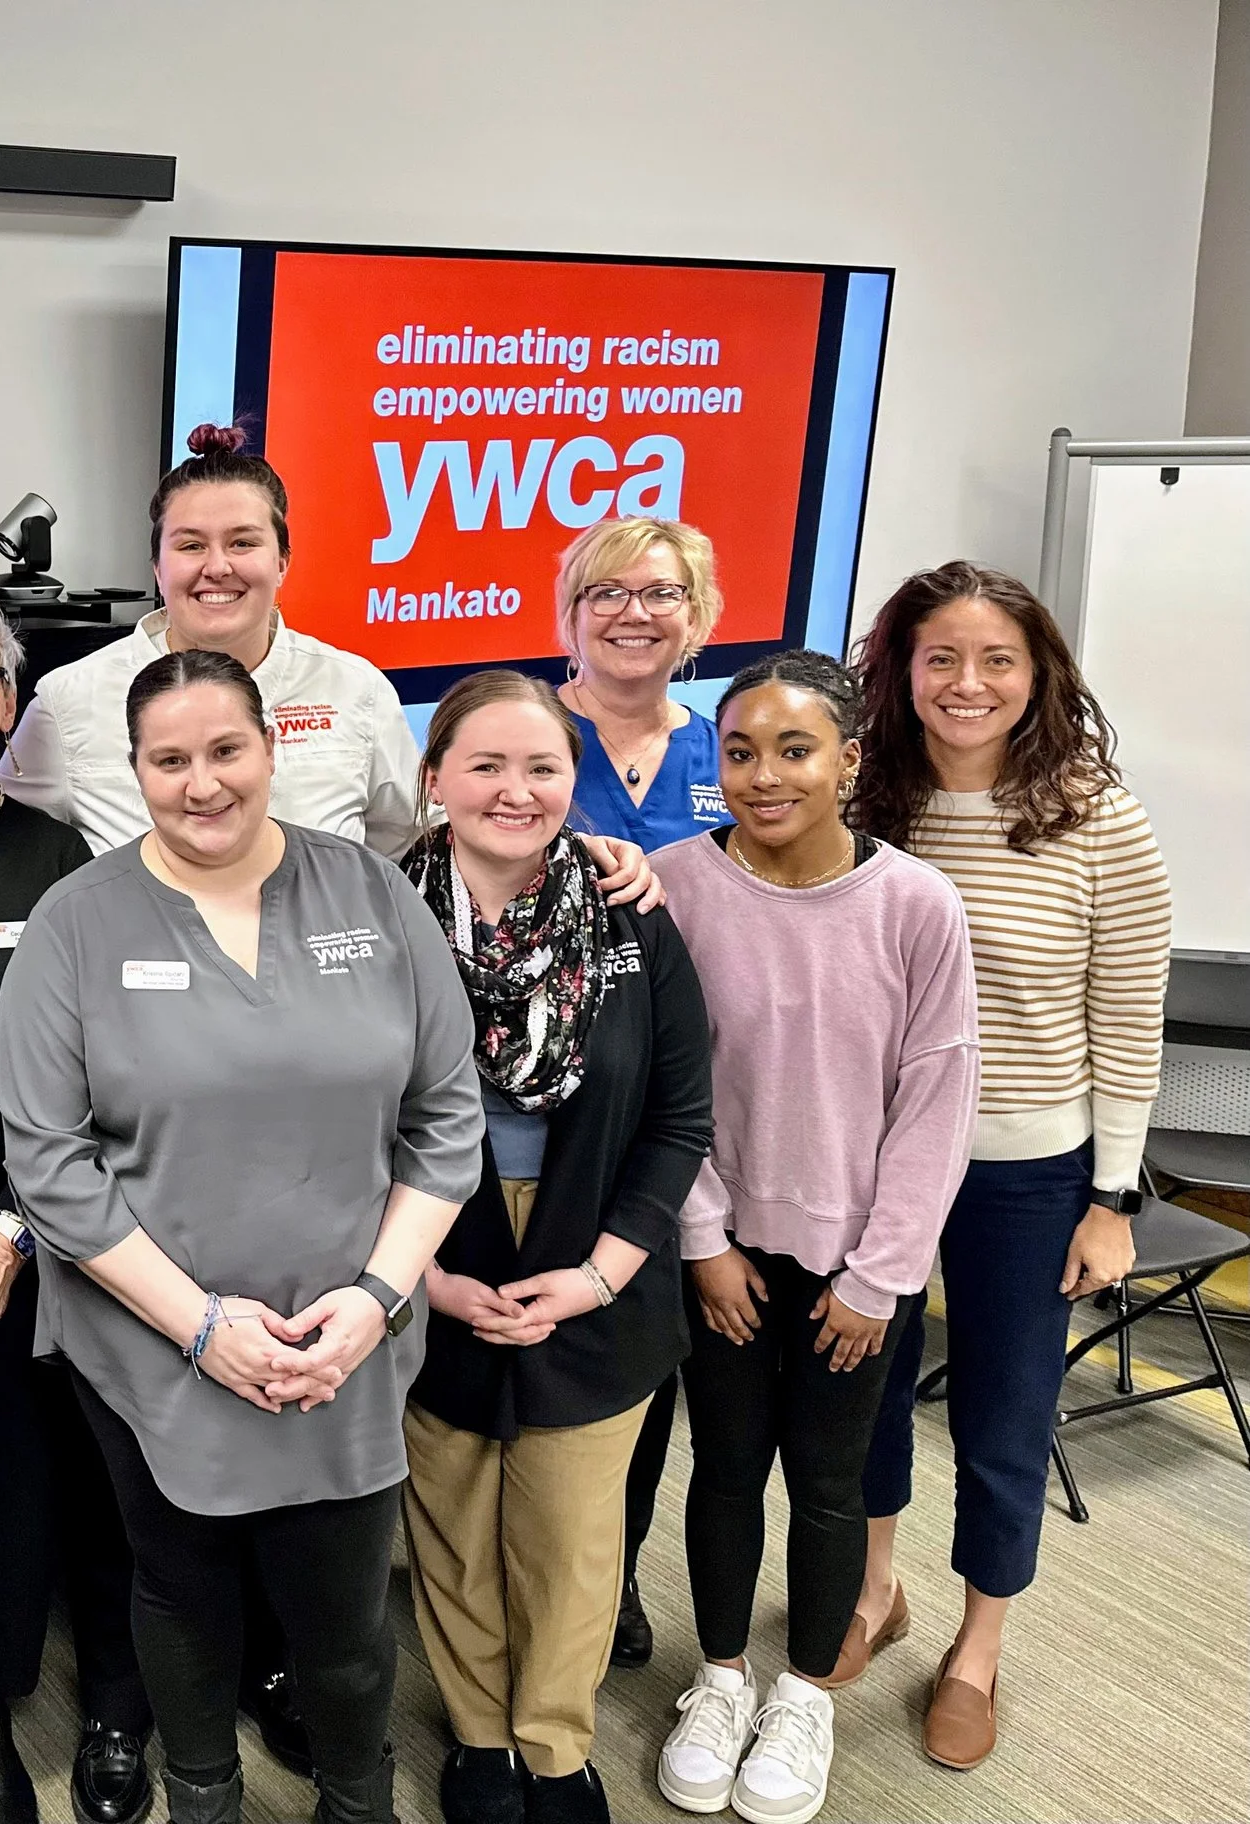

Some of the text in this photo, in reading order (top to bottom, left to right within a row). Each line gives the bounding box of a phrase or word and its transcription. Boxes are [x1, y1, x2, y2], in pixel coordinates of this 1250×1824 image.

[376, 325, 720, 374] eliminating racism
[372, 378, 743, 425] empowering women
[371, 434, 686, 565] ywca
[366, 581, 521, 624] Mankato
[276, 717, 332, 737] ywca
[691, 796, 729, 814] ywc
[312, 942, 374, 967] ywca
[601, 957, 641, 977] wca
